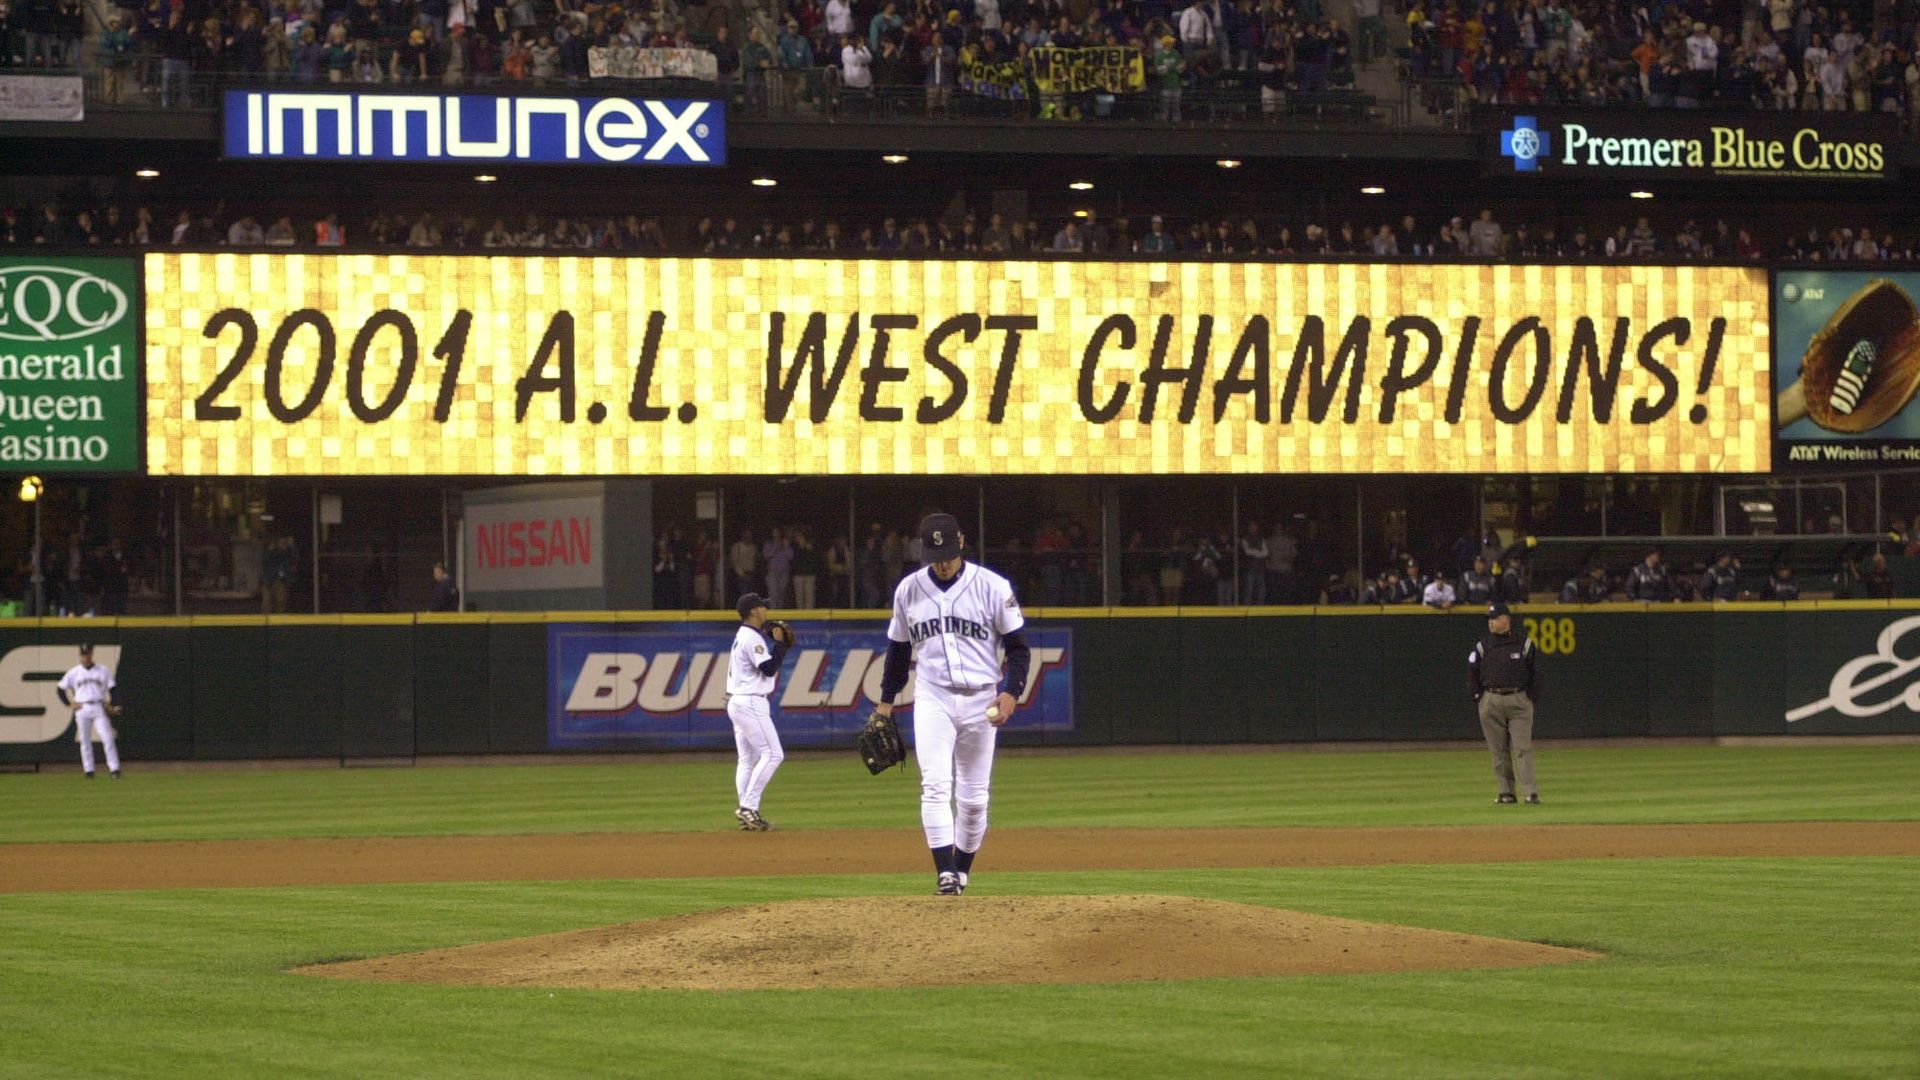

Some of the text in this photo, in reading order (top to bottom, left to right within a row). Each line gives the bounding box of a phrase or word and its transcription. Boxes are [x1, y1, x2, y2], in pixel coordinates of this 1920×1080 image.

[1562, 123, 1884, 170] Premera Blue Cross
[0, 344, 123, 380] merald
[195, 309, 1726, 424] 2001 A.L. WEST CHAMPIONS!
[0, 390, 104, 427] ueen
[0, 425, 109, 461] asino
[1790, 445, 1920, 461] AT&T Wireless Servic
[477, 516, 591, 569] NISSAN
[933, 531, 943, 545] S
[909, 616, 989, 643] MARINERS
